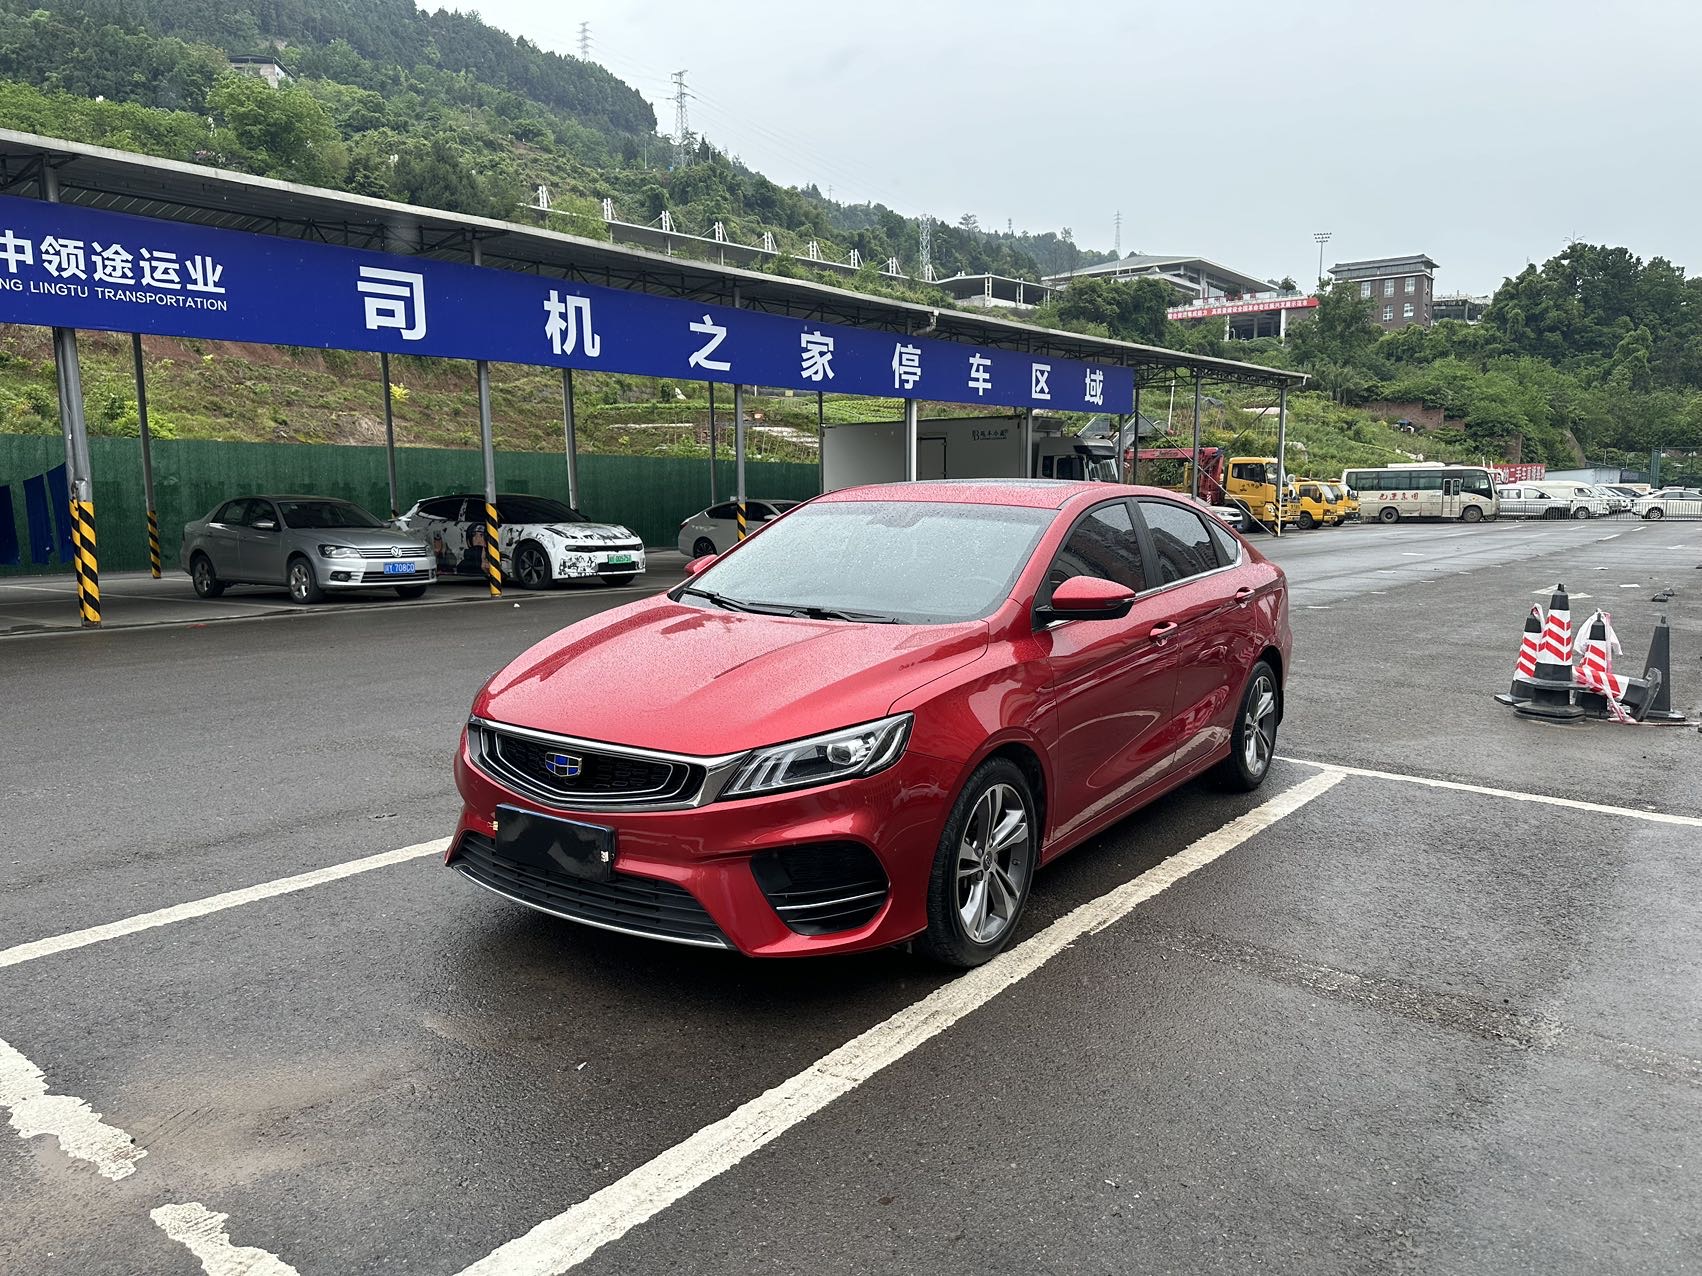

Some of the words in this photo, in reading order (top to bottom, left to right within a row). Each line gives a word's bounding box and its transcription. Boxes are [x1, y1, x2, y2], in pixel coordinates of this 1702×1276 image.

[0, 230, 226, 294] 中领途运业
[30, 281, 88, 298] LINGTU
[97, 287, 227, 311] TRANSPORTATION
[357, 266, 1104, 406] 司机之家停车区域
